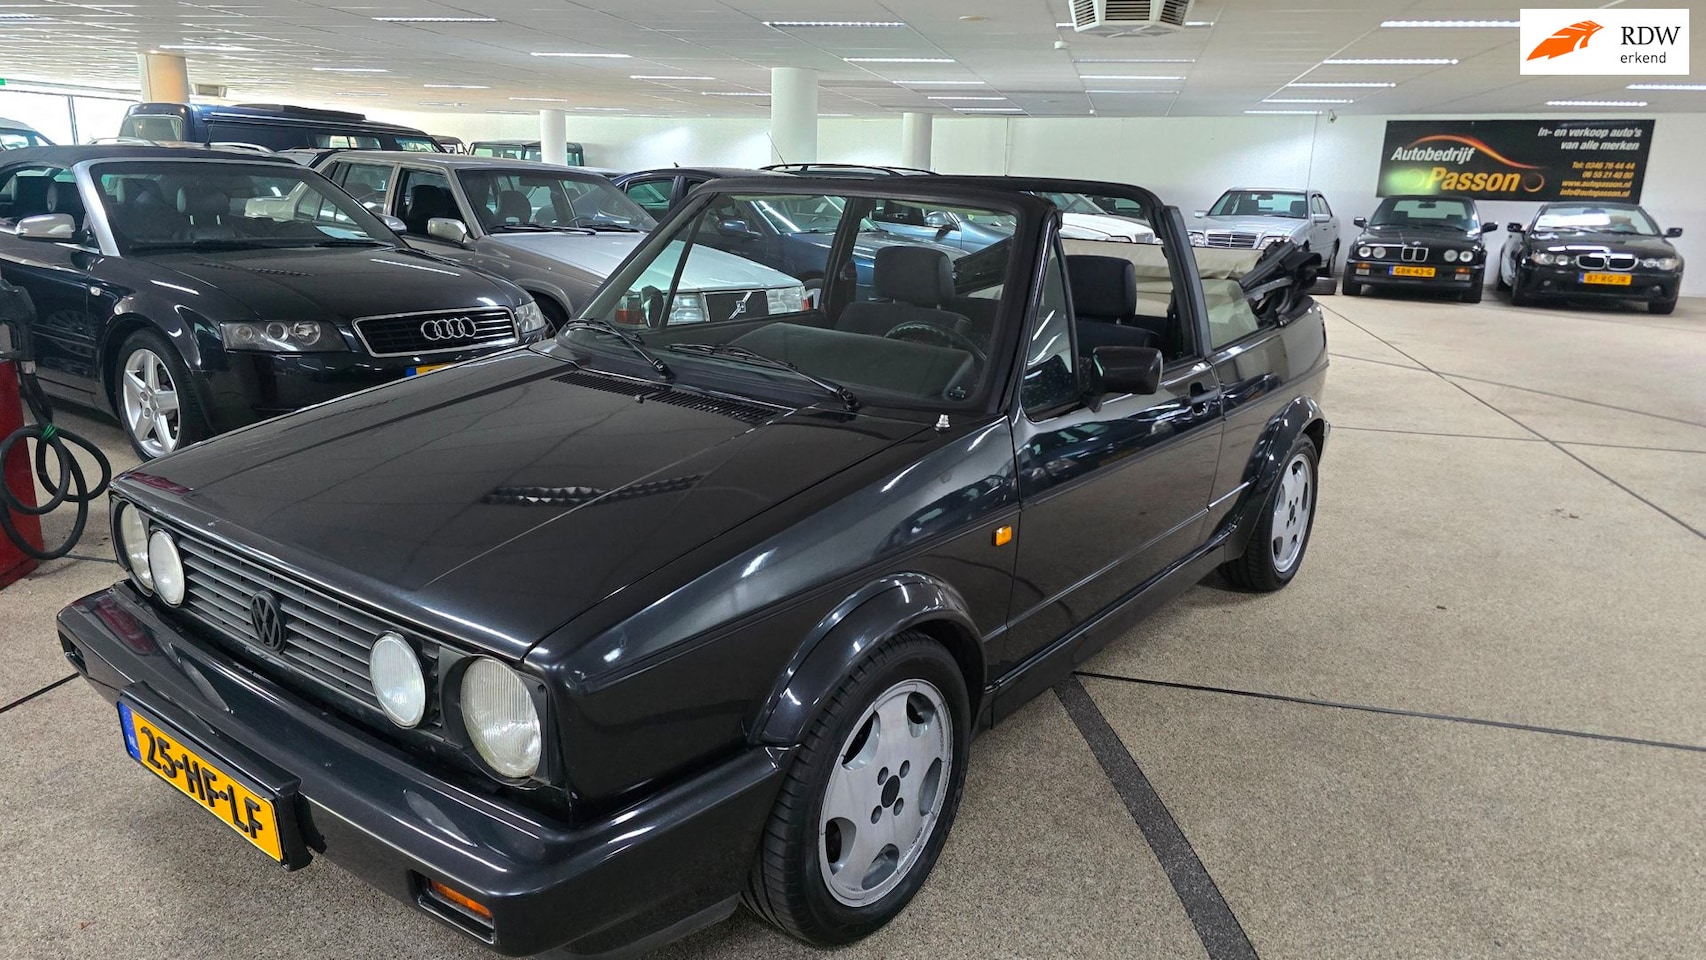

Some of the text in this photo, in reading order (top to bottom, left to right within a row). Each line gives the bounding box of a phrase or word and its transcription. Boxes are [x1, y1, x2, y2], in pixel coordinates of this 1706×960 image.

[1537, 127, 1642, 139] In- en verkoop auto's
[1560, 140, 1640, 150] van alle merken
[1391, 146, 1475, 164] Autobedrijf
[1426, 166, 1521, 191] Passon
[140, 726, 263, 840] 25-HF-LF
